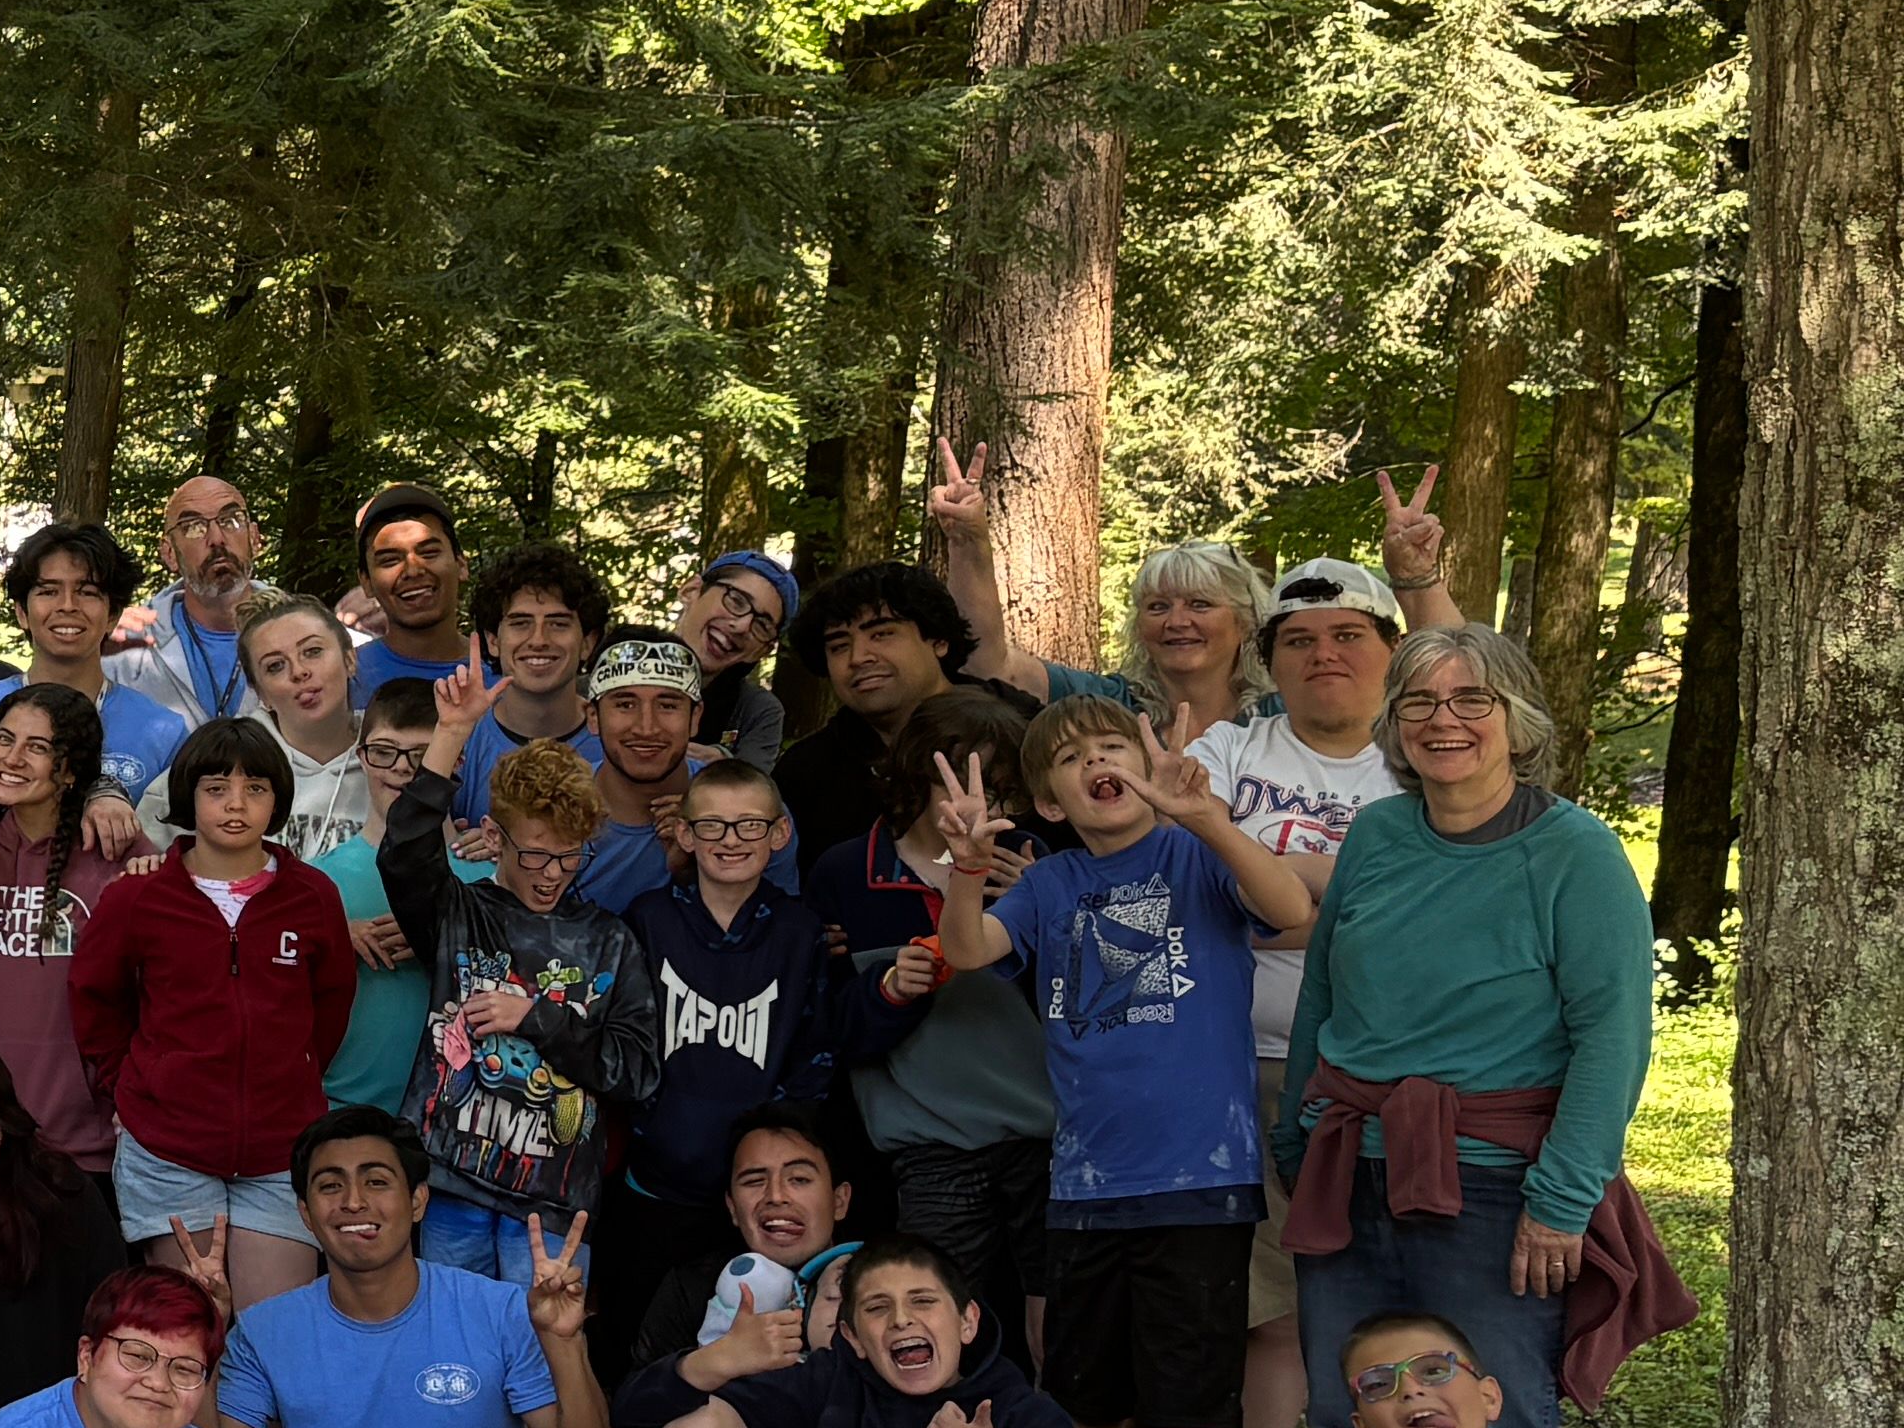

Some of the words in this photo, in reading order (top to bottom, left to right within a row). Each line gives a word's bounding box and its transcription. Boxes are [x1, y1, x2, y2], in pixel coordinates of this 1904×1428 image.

[0, 885, 45, 909] THE
[280, 931, 298, 958] C
[660, 957, 778, 1071] TAPOUT
